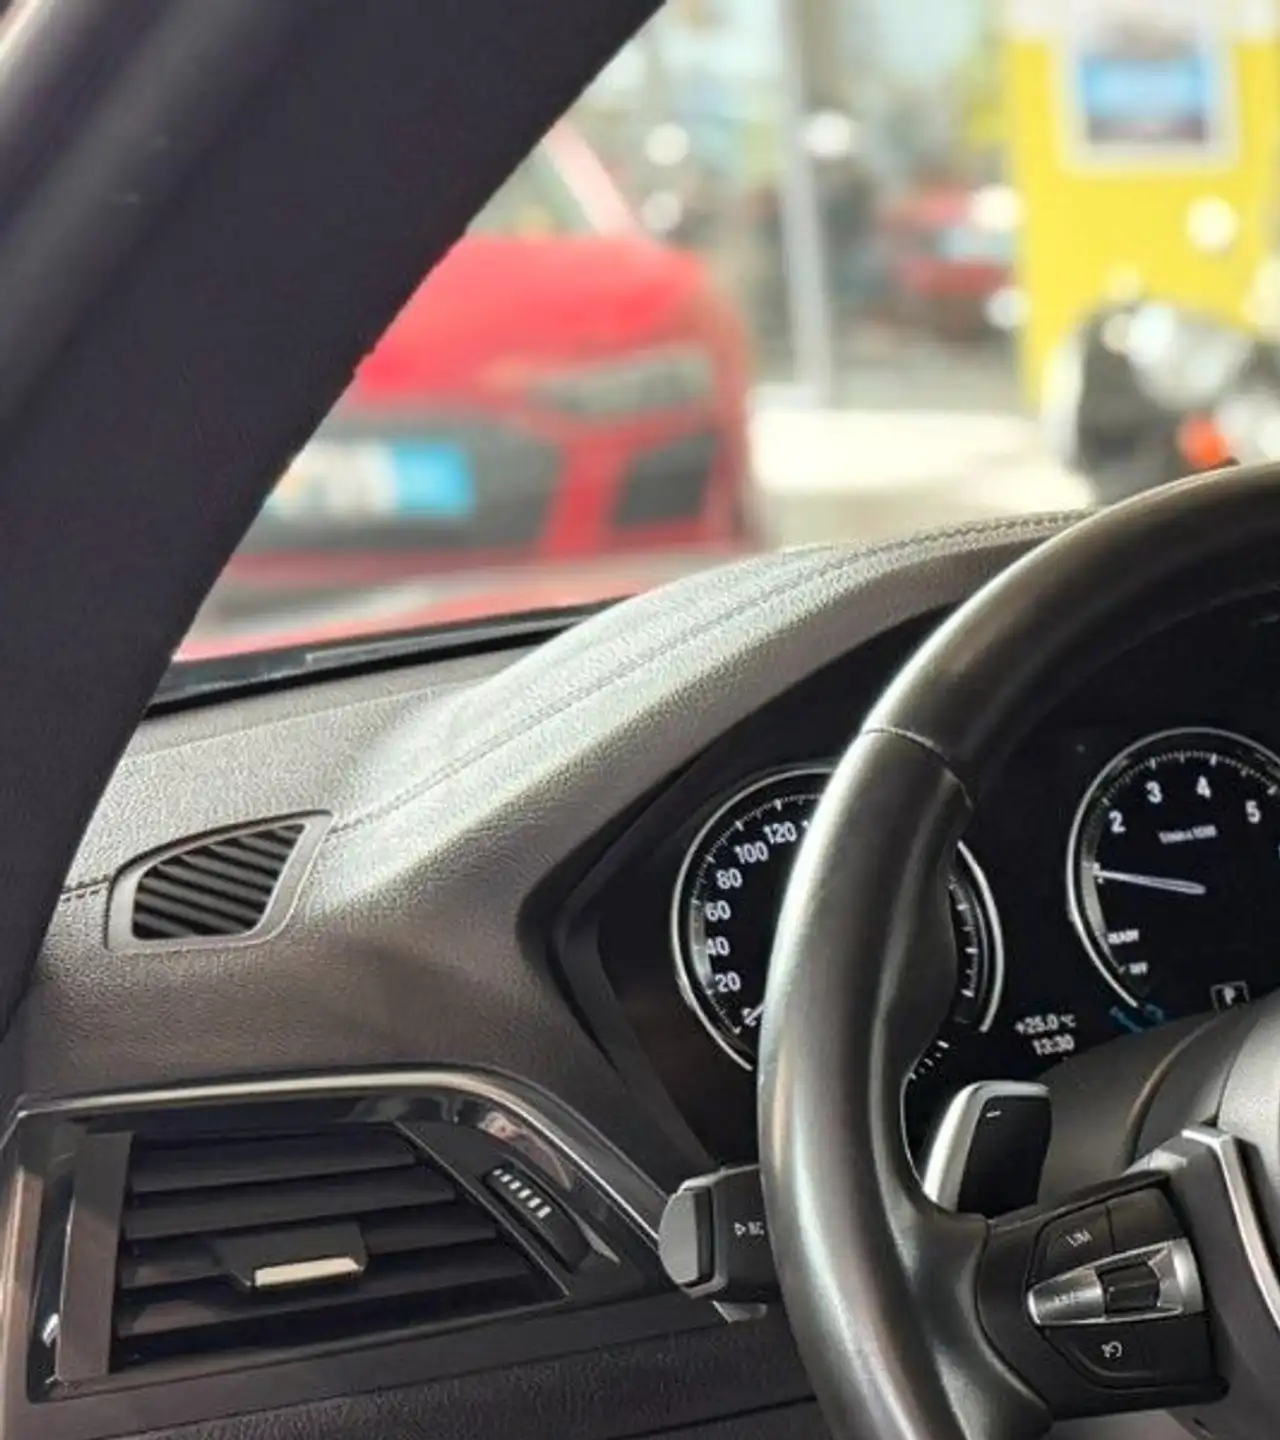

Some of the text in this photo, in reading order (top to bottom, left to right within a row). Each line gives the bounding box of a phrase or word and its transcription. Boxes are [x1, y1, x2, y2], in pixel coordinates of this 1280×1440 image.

[1145, 781, 1163, 804] 3
[1196, 775, 1211, 799] 4
[1109, 810, 1126, 833] 2
[1245, 800, 1261, 824] 5
[763, 821, 797, 844] 120
[734, 841, 769, 864] 100
[716, 868, 743, 890] 80
[705, 900, 731, 921] 60
[706, 936, 731, 957] 40
[715, 972, 741, 993] 20
